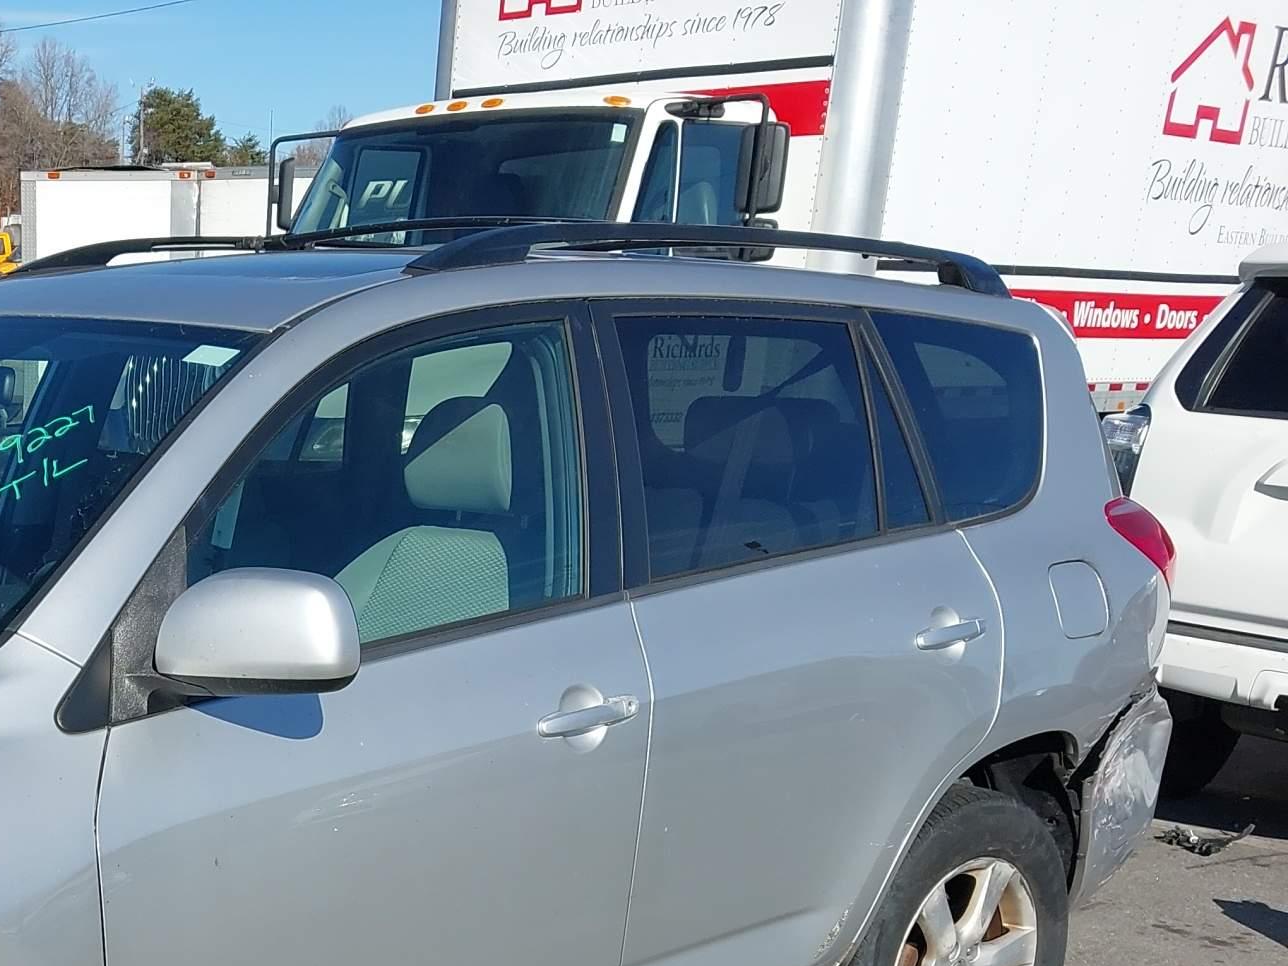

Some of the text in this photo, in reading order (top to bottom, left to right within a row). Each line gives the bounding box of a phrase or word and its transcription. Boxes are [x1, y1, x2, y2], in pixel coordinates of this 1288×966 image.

[498, 1, 785, 70] Building relationships since 1978
[1146, 158, 1218, 235] Building
[1073, 300, 1198, 329] Windows Doors
